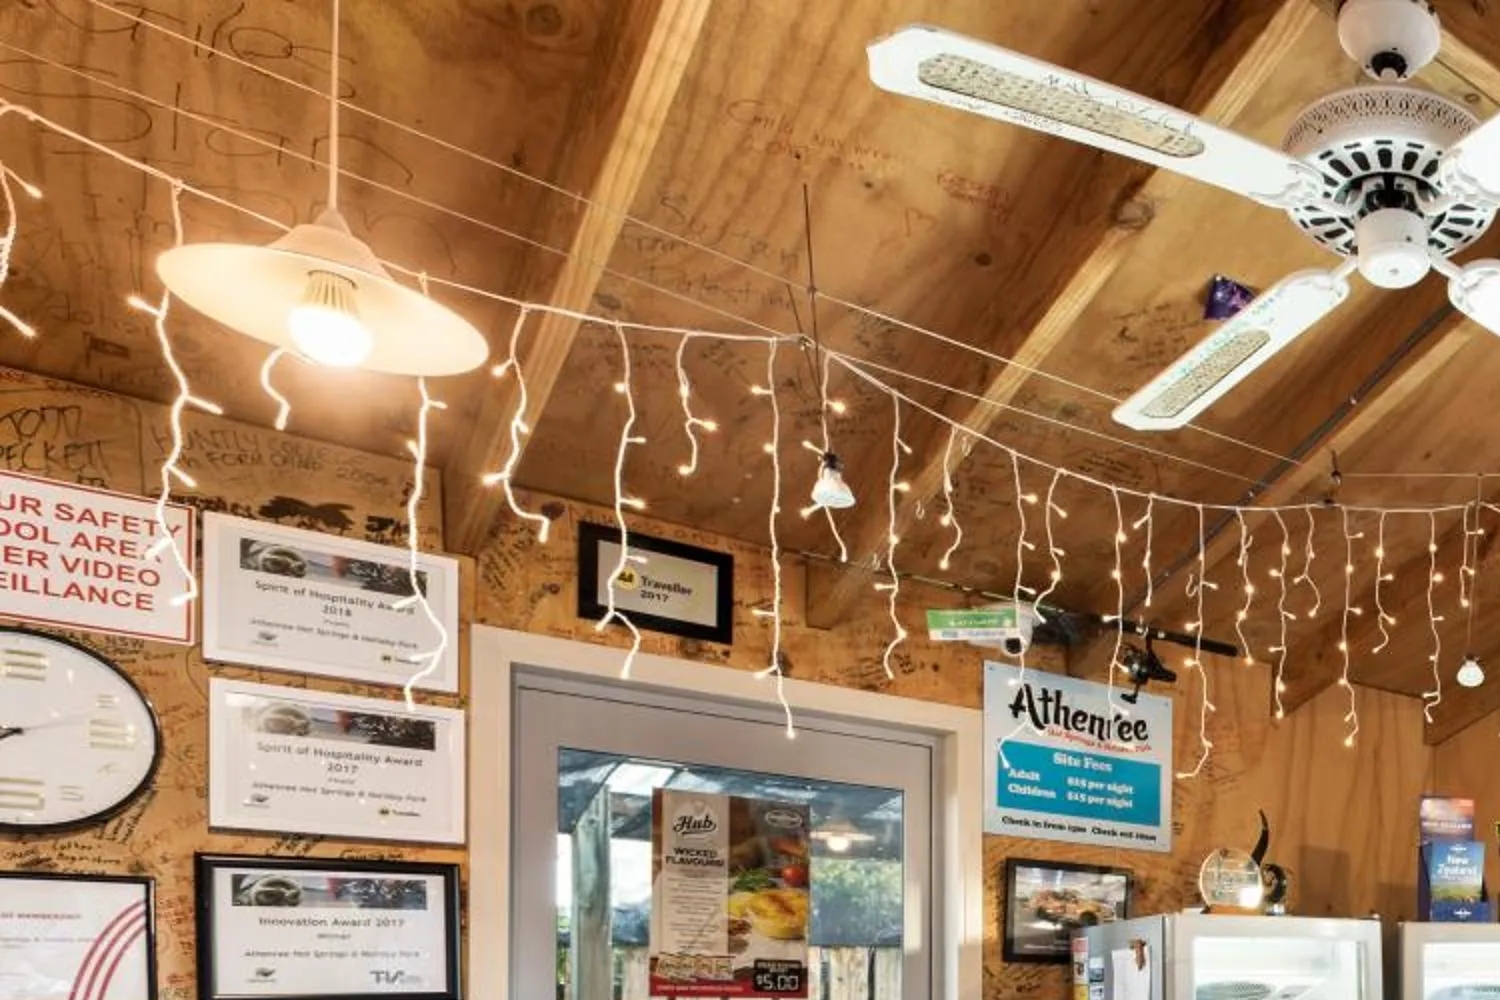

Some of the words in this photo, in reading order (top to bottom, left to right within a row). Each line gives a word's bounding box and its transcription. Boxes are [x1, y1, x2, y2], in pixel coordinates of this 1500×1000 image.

[54, 503, 183, 538] SAFETY
[60, 554, 161, 588] VIDEO
[255, 580, 289, 595] Spirit
[293, 587, 306, 597] of
[309, 589, 375, 609] Hospitality
[641, 575, 693, 596] Traveller
[641, 589, 669, 602] 2017
[1008, 683, 1149, 742] Athenree
[256, 741, 291, 753] Spirit
[294, 746, 309, 755] of
[313, 748, 381, 764] Hospitality
[384, 755, 423, 767] Award
[1053, 752, 1081, 768] Site
[1083, 755, 1113, 772] Fees
[326, 762, 359, 774] 2017
[1007, 768, 1041, 782] Adult
[1087, 779, 1105, 791] per
[1106, 780, 1135, 796] night
[1007, 783, 1057, 799] Children
[1087, 794, 1105, 806] per
[1106, 795, 1134, 809] night
[673, 813, 717, 835] Hub
[1001, 815, 1031, 827] Check
[1032, 819, 1043, 828] in
[1043, 820, 1066, 831] from
[1091, 827, 1118, 838] Check
[673, 847, 718, 858] WICKED
[1447, 856, 1469, 864] New
[259, 916, 329, 928] Innovation
[331, 917, 371, 928] Award
[375, 917, 406, 928] 2017
[756, 975, 799, 991] $5.00
